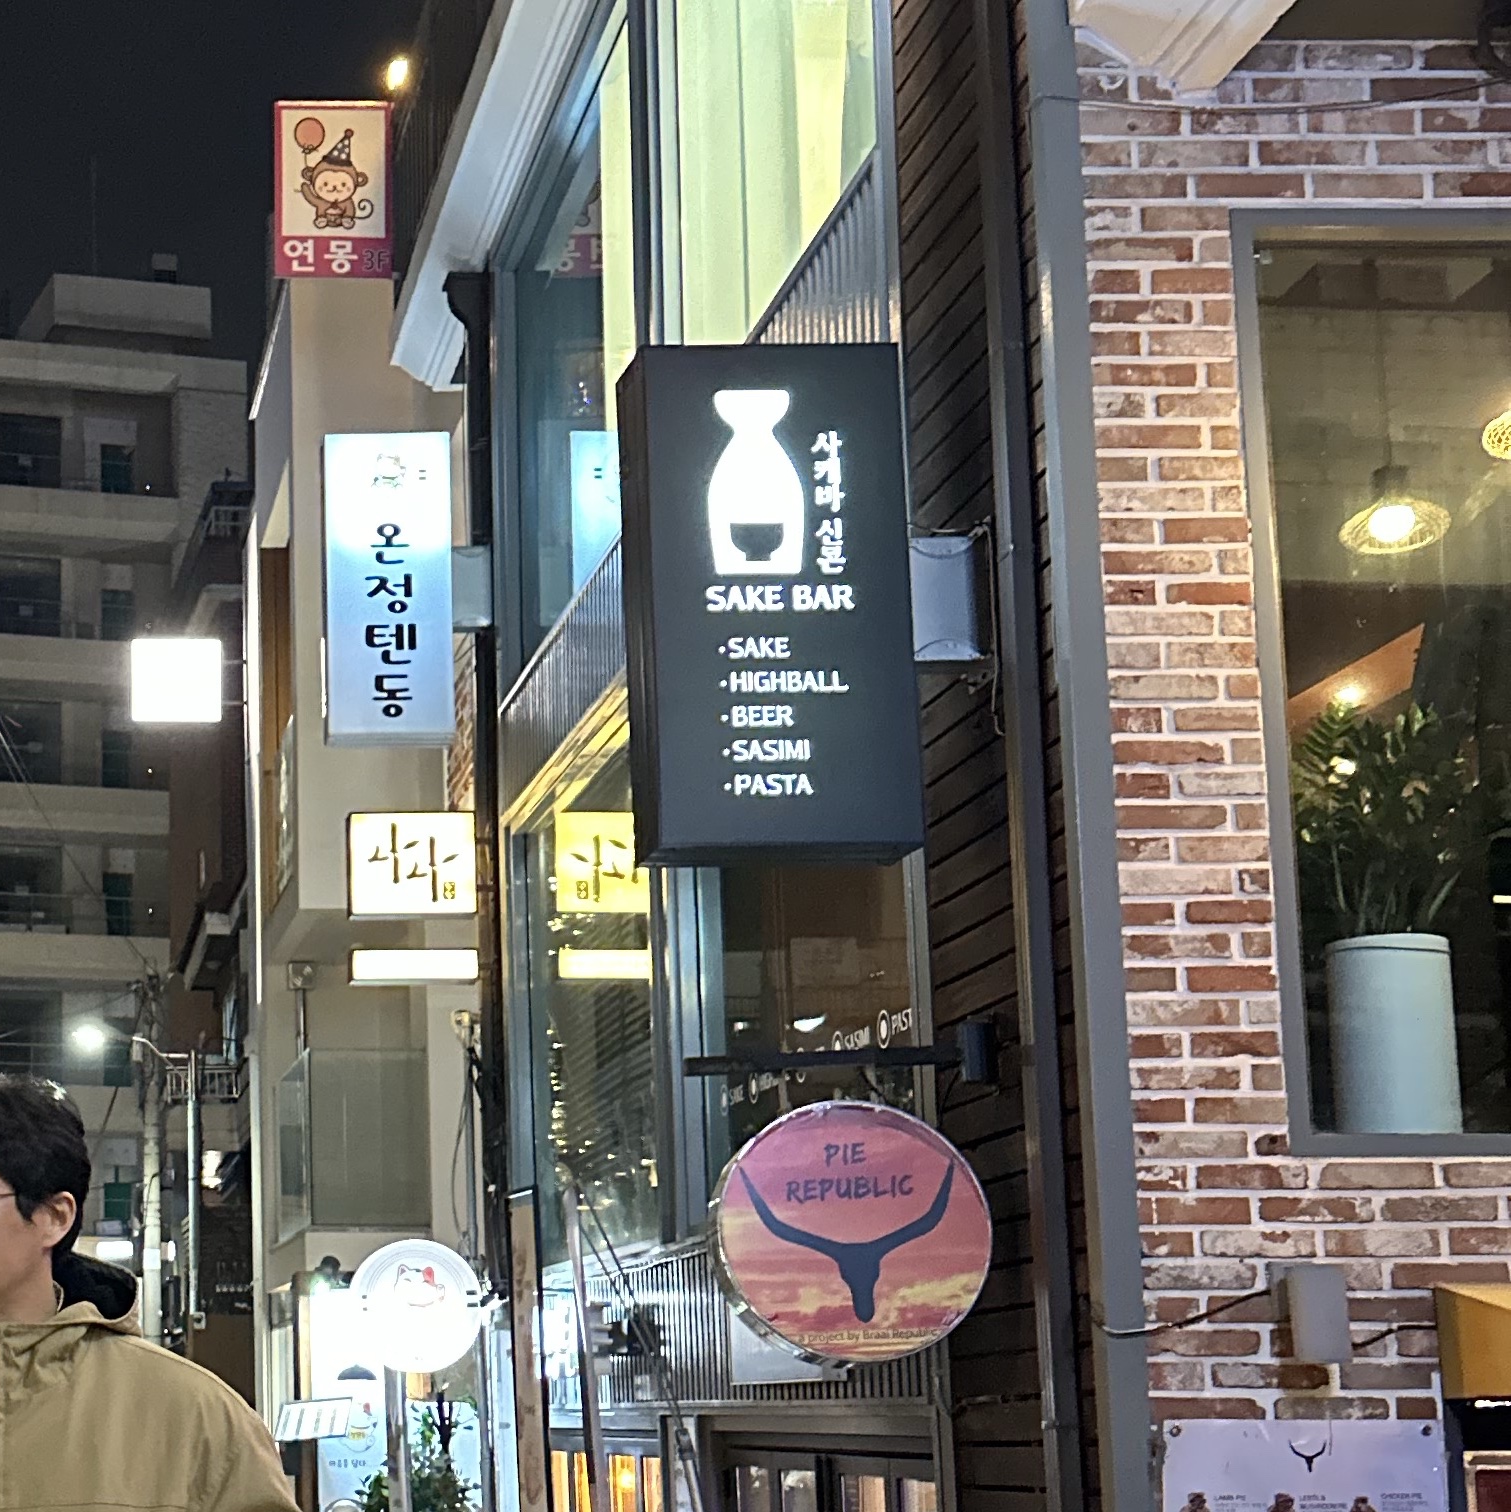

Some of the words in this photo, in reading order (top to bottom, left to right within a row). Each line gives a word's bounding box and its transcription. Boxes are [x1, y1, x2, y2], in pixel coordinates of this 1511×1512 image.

[362, 249, 389, 272] 3F
[705, 584, 785, 611] SAKE
[791, 584, 855, 611] BAR
[364, 522, 417, 718] 온정텐동
[727, 636, 791, 659] SAKE
[729, 670, 850, 693] HIGHBALL
[731, 704, 794, 728] BEER
[731, 738, 811, 762] SASIMI
[733, 773, 815, 796] PASTA
[824, 1142, 867, 1167] PIE
[785, 1174, 914, 1205] REPUBLIC
[808, 1331, 844, 1346] project
[847, 1332, 860, 1343] by
